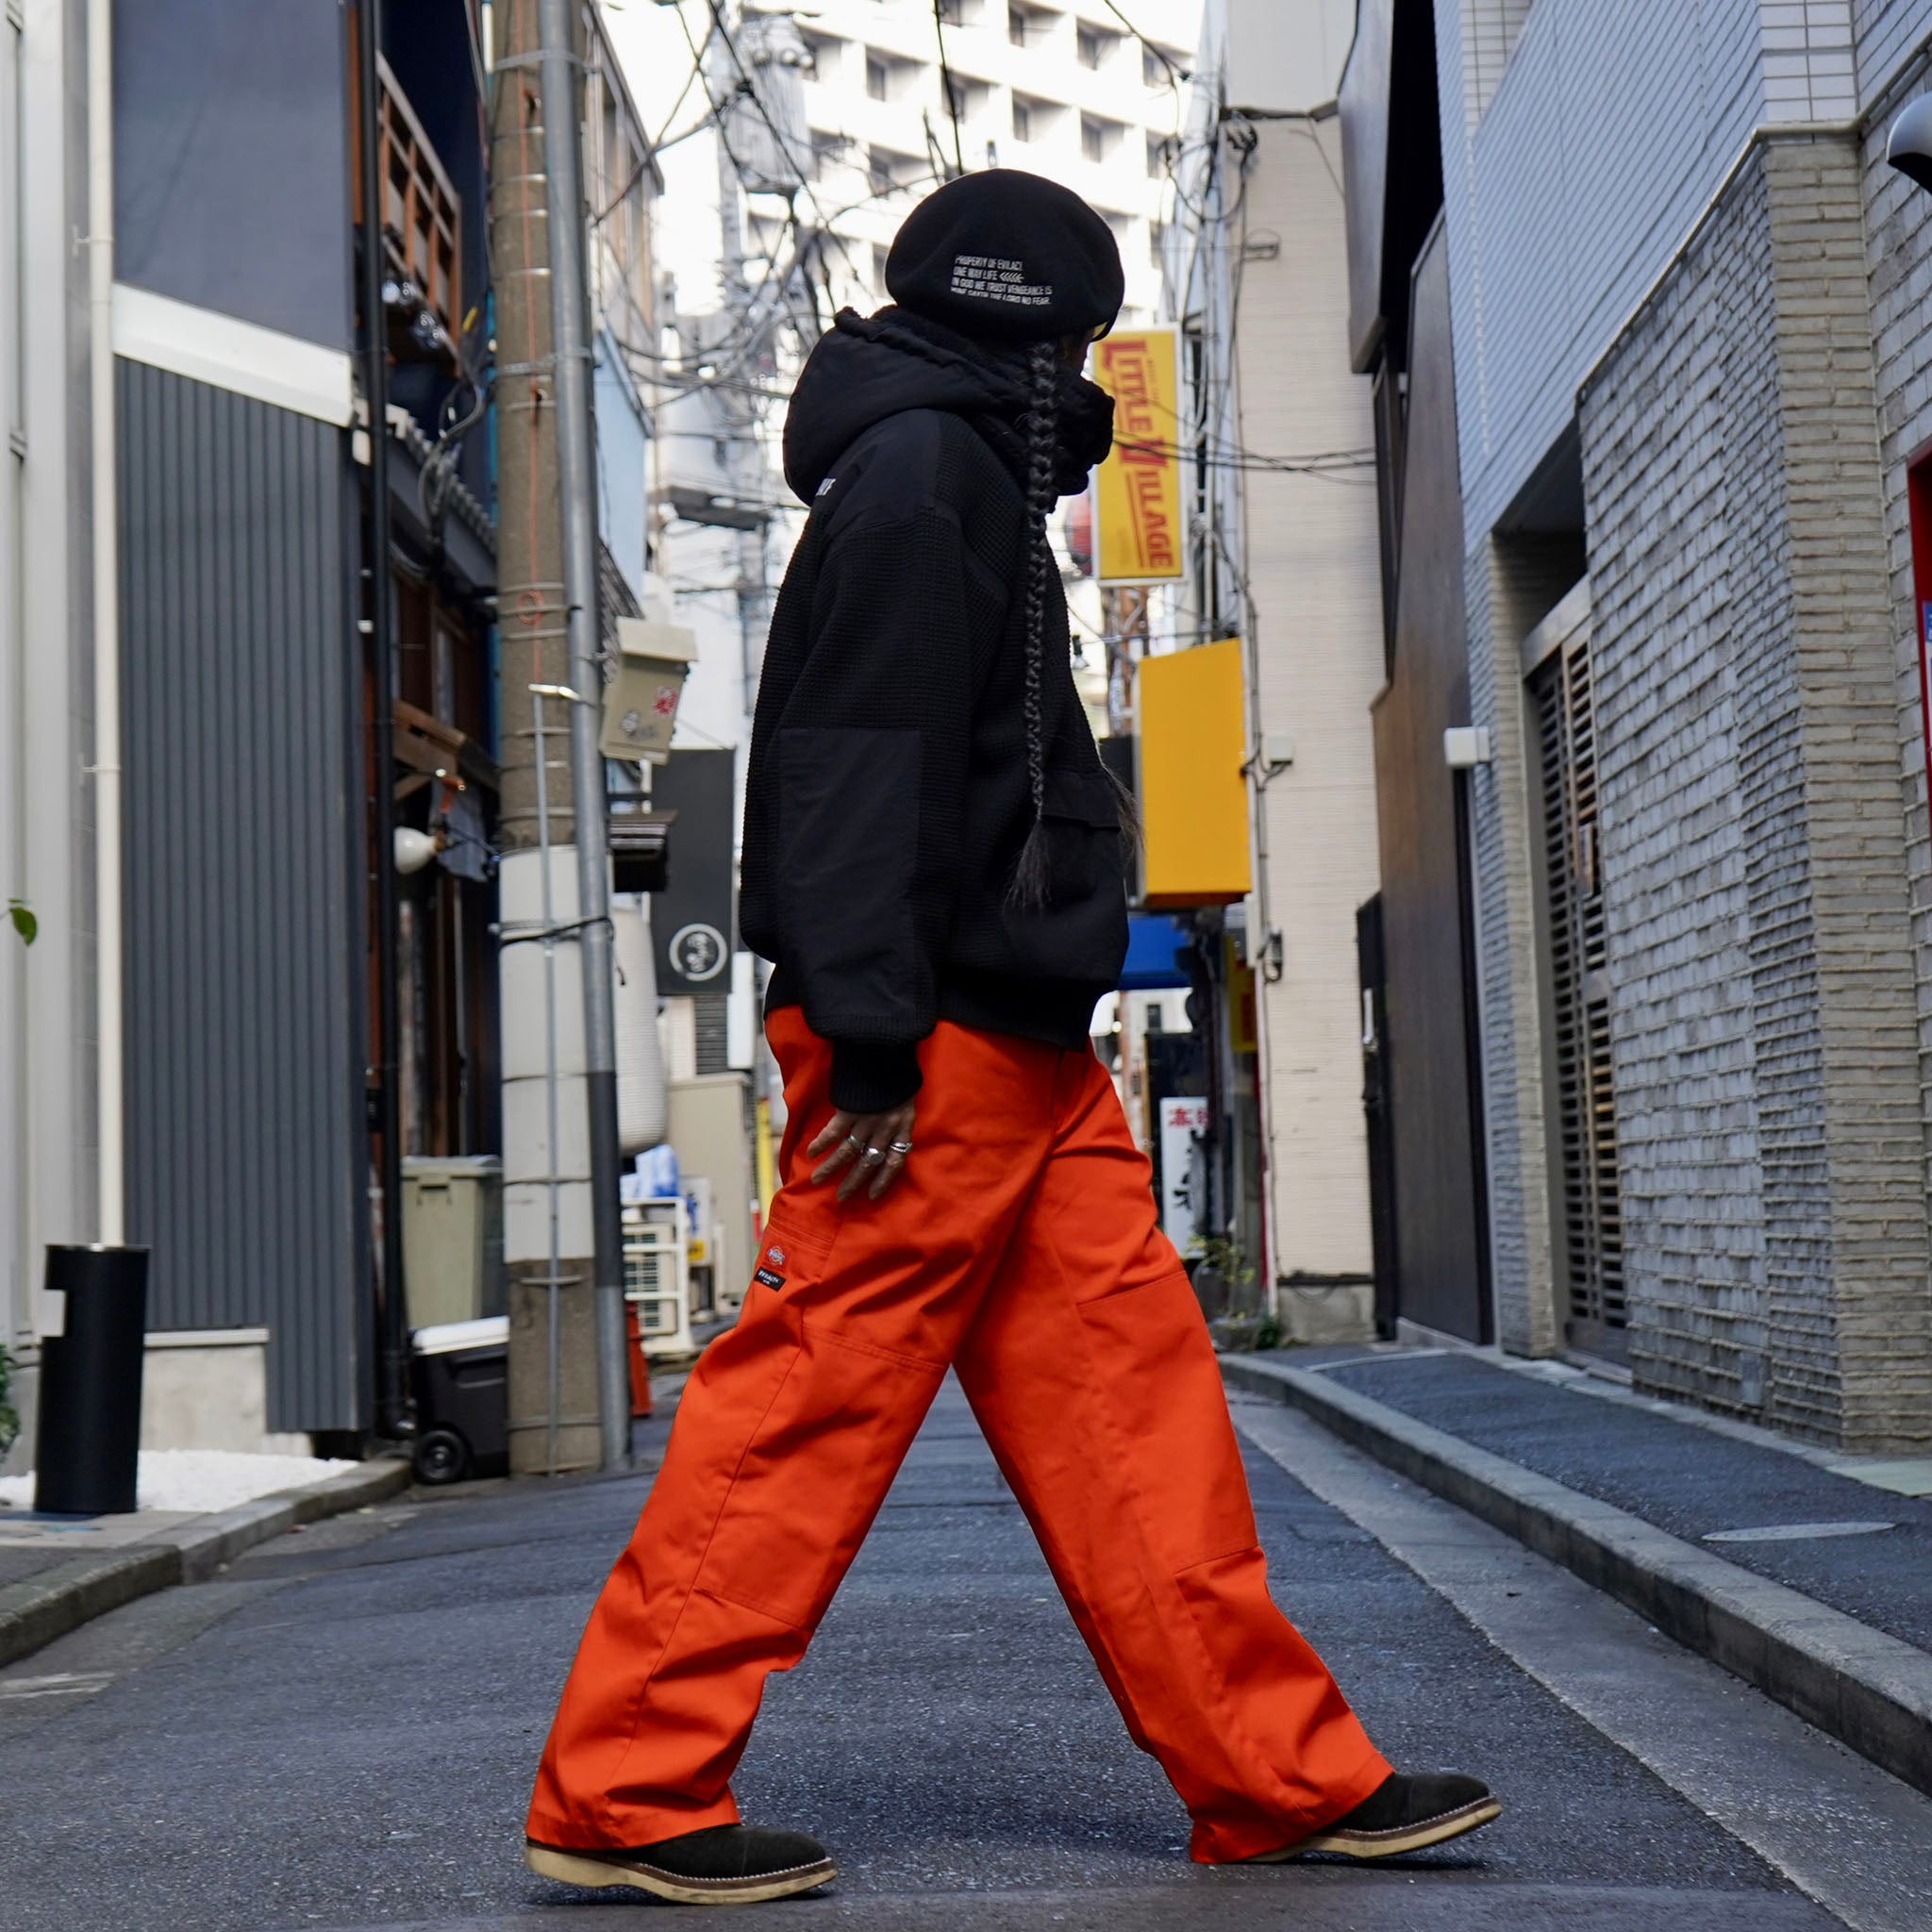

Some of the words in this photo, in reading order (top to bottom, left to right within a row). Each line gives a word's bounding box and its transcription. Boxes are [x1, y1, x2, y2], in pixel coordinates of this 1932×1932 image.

[988, 258, 997, 268] OF
[953, 266, 967, 276] ONE
[968, 268, 982, 278] WAY
[983, 269, 998, 280] LIFE
[951, 276, 959, 286] IN
[960, 278, 974, 289] GOD
[974, 281, 986, 291] WE
[987, 281, 1007, 292] TRUST
[1008, 284, 1044, 295] VENGEANCE
[1044, 286, 1053, 295] IS
[1022, 296, 1032, 305] NO
[1119, 436, 1174, 568] VILLAGE
